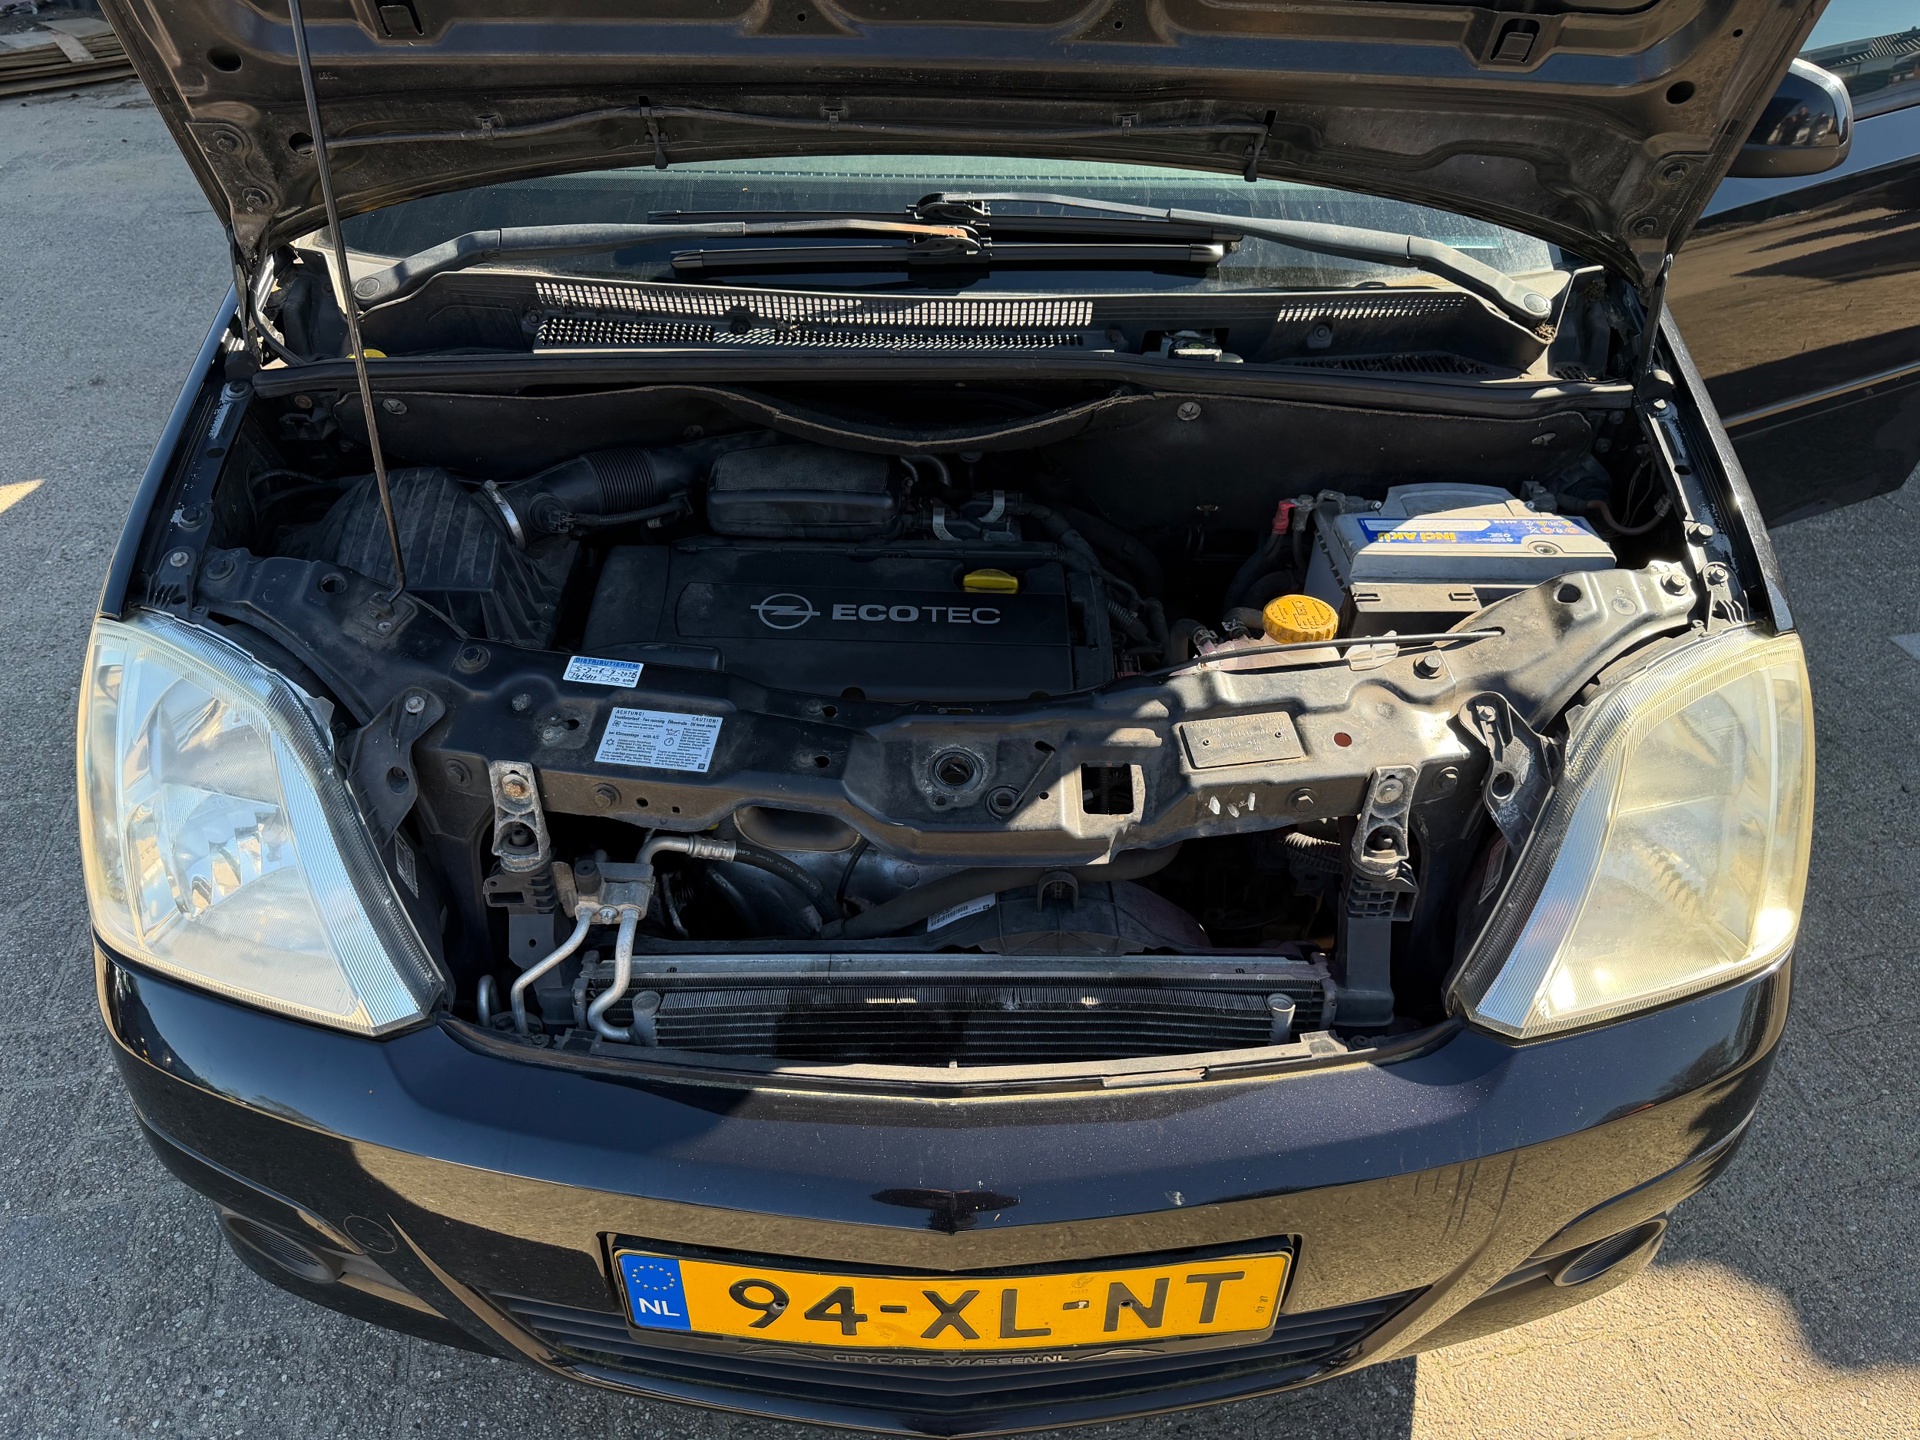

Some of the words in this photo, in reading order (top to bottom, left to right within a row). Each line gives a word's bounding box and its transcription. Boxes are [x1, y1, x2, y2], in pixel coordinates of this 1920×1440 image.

[832, 604, 1001, 625] ECOTEC
[616, 709, 645, 717] ACHTUNG!
[639, 1297, 681, 1317] NL
[729, 1270, 1246, 1340] 94-XL-NT
[832, 1354, 1070, 1367] CITYCARS-VAASSEN.NL
